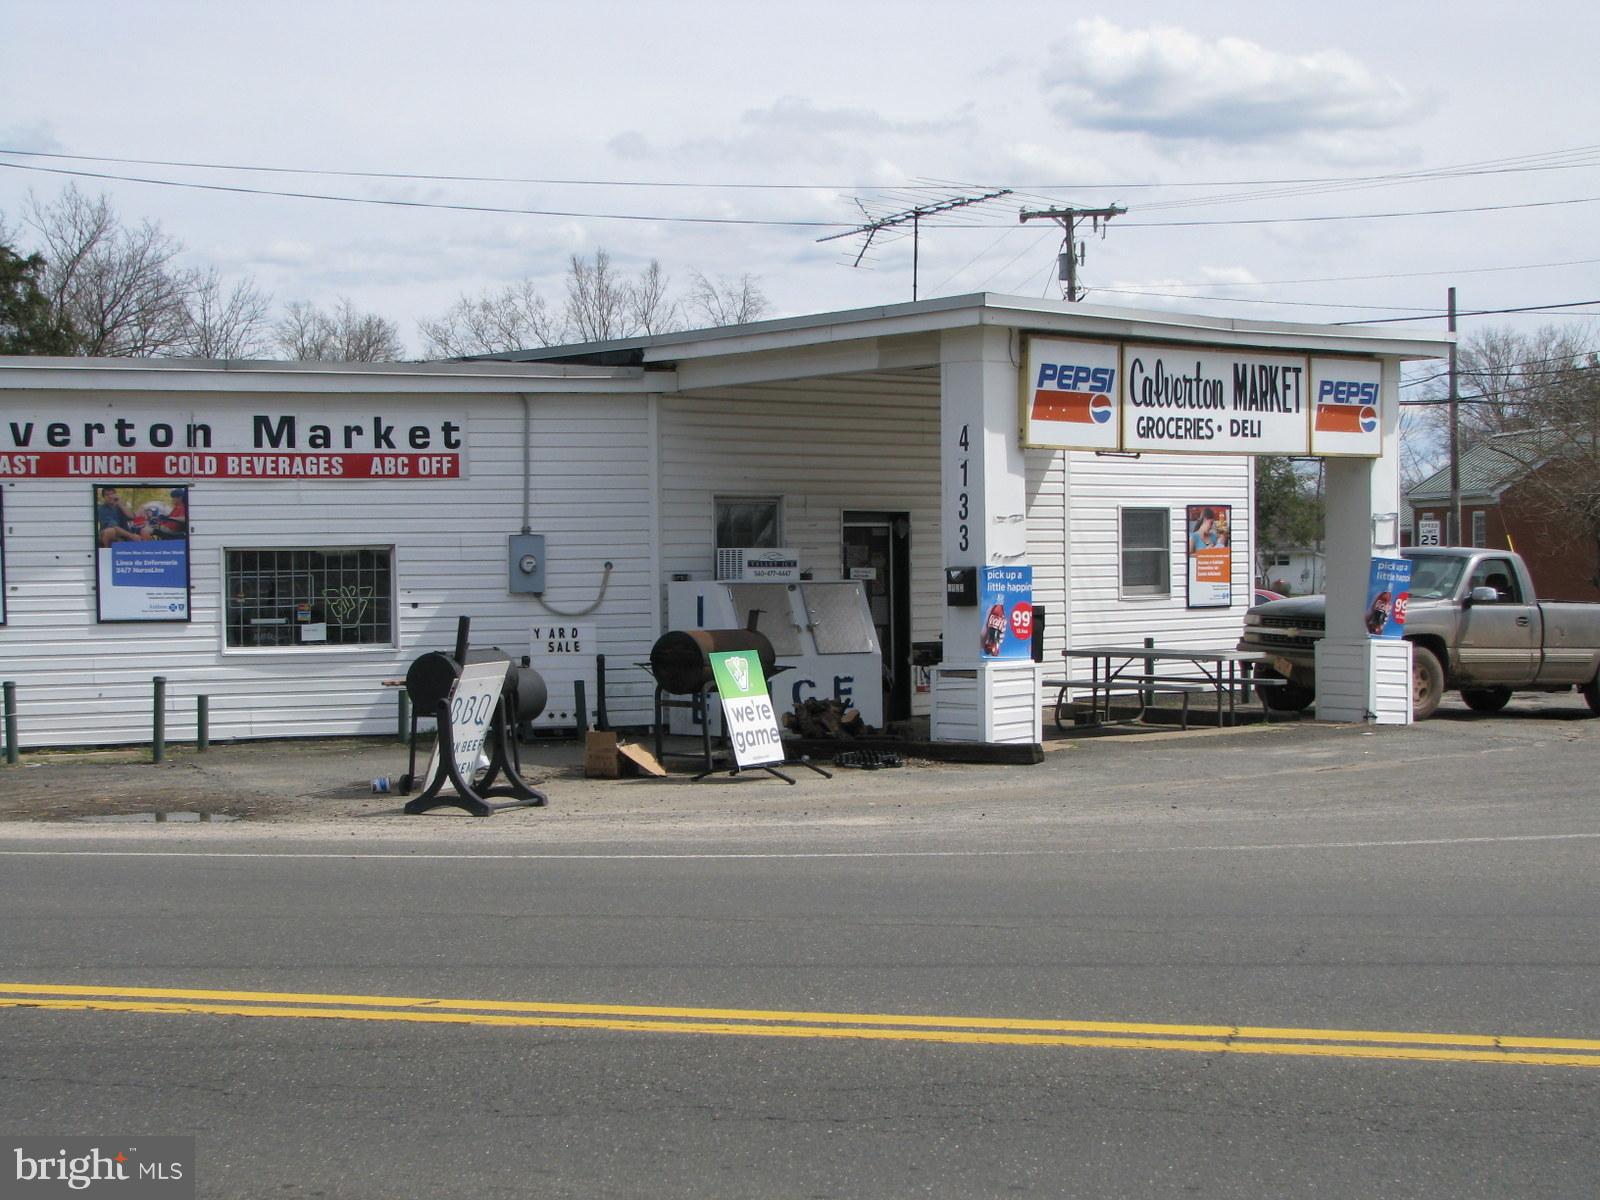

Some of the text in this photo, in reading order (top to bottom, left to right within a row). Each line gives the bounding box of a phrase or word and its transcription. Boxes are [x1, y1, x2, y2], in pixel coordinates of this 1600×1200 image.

[1037, 364, 1115, 392] PEPSI
[1129, 358, 1302, 413] Calverton MARKET
[1318, 380, 1380, 404] PEPSI
[252, 415, 461, 449] Market
[1136, 416, 1262, 440] GROCERIES DELI
[68, 455, 137, 475] LUNCH
[164, 456, 217, 475] COLD
[227, 456, 343, 475] BEVERAGES
[370, 457, 409, 475] ABC
[418, 457, 453, 475] OFF
[958, 424, 969, 552] 4133
[1421, 535, 1438, 545] 25
[987, 570, 1004, 580] pick
[1006, 571, 1016, 580] up
[987, 582, 1006, 592] little
[548, 641, 580, 652] SALE
[731, 700, 771, 722] we're
[735, 727, 780, 753] game
